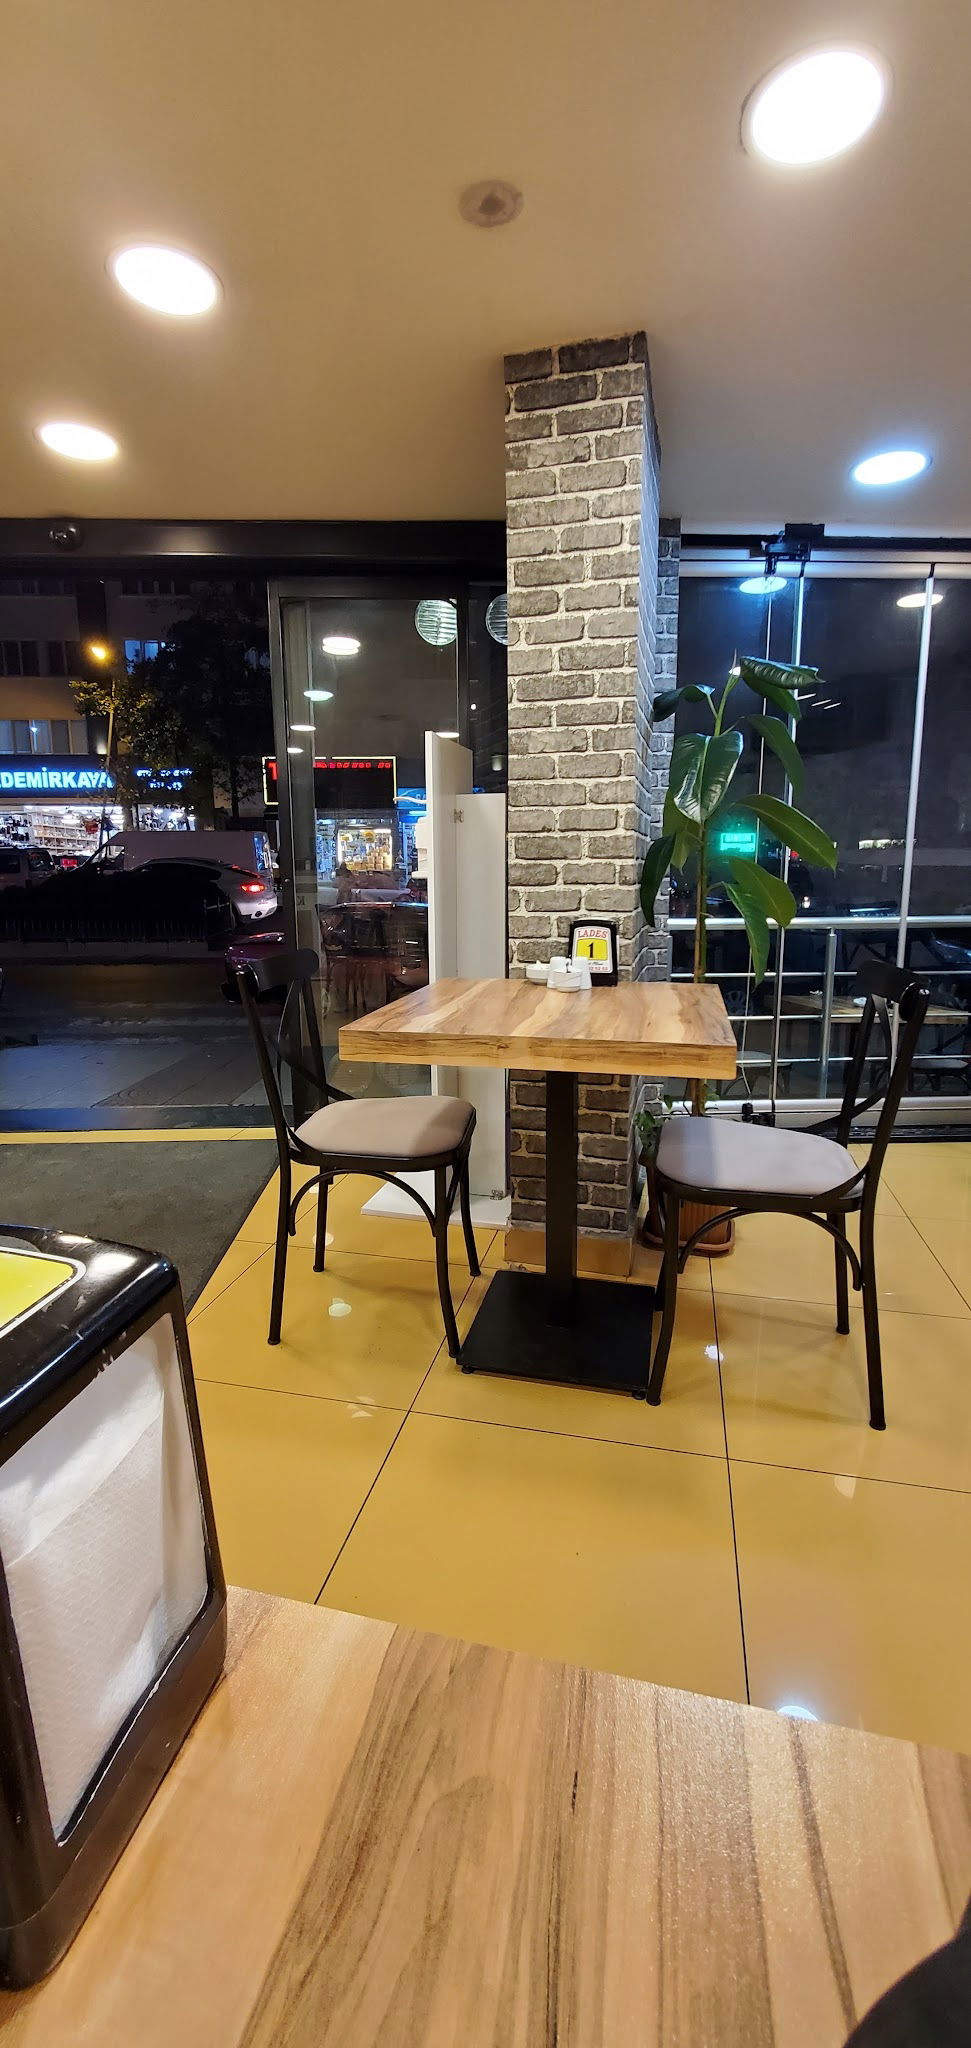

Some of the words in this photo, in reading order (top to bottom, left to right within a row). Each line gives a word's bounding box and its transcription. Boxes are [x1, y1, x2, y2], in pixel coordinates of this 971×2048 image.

[0, 766, 115, 788] DEMİRKAYA
[577, 929, 608, 939] LADES
[587, 942, 594, 959] 1
